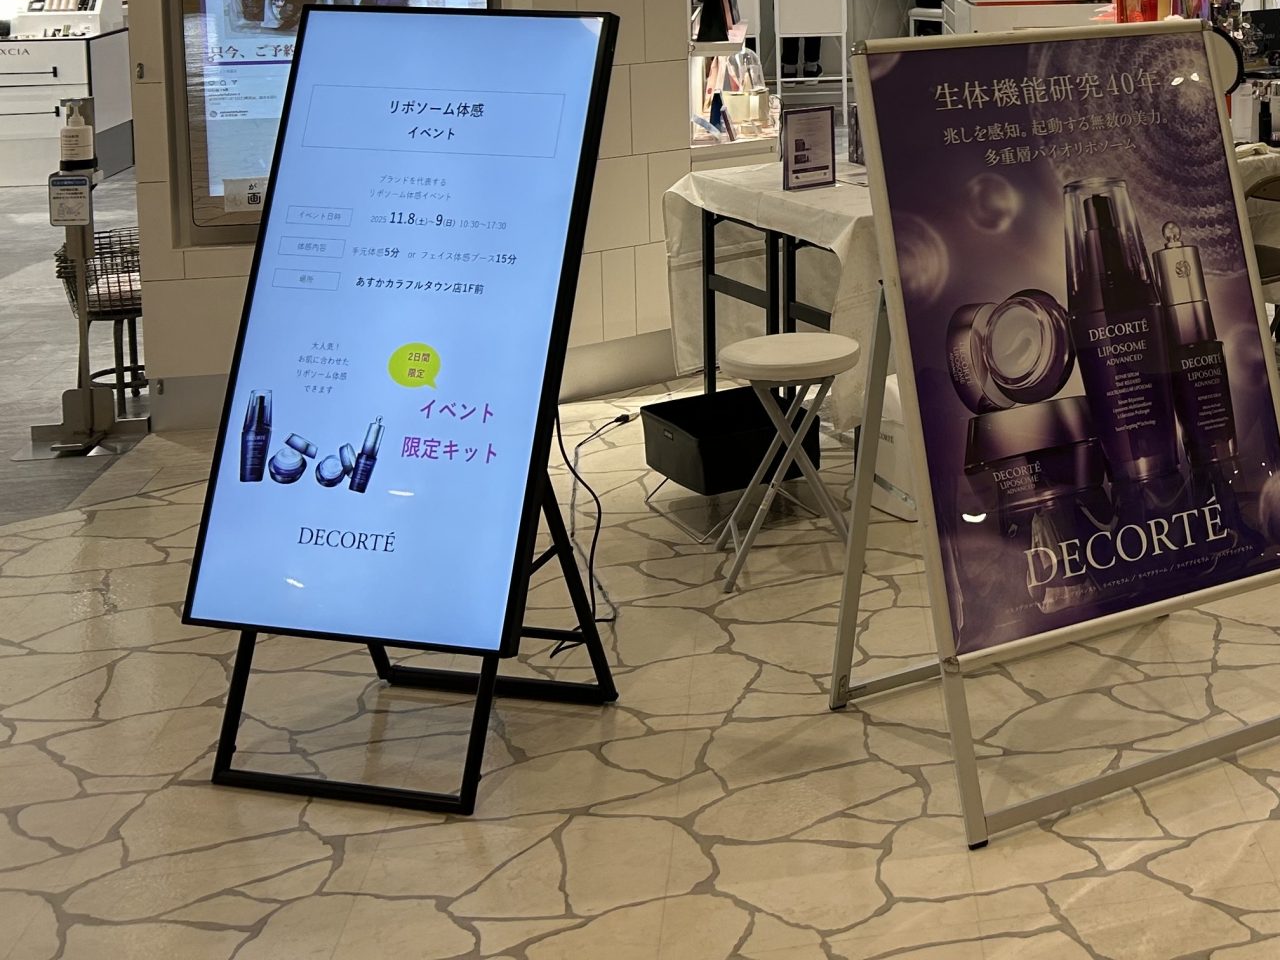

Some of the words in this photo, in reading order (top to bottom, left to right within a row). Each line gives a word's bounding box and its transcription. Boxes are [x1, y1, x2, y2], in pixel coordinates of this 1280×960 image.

[934, 68, 1161, 113] 生体機能研究40年
[389, 100, 485, 118] リポソーム体感
[408, 126, 456, 141] イベント
[984, 138, 1137, 168] 多重層バイオリポソーム
[248, 192, 261, 205] 画
[370, 215, 387, 223] 2025
[407, 251, 417, 259] or
[355, 276, 485, 296] あすかカラフルタウン店1F前
[1089, 318, 1150, 342] DECORTÉ
[407, 352, 431, 363] 2日間
[1097, 340, 1147, 358] LIPOSOME
[1106, 353, 1143, 366] ADVANCED
[407, 368, 425, 379] 限定
[420, 399, 495, 424] イベント
[401, 436, 498, 464] 限定キット
[993, 461, 1042, 482] DECORTÉ
[1000, 475, 1039, 490] LIPOSOME
[297, 526, 396, 553] DECORTÉ
[1023, 495, 1229, 589] DECORTÉ
